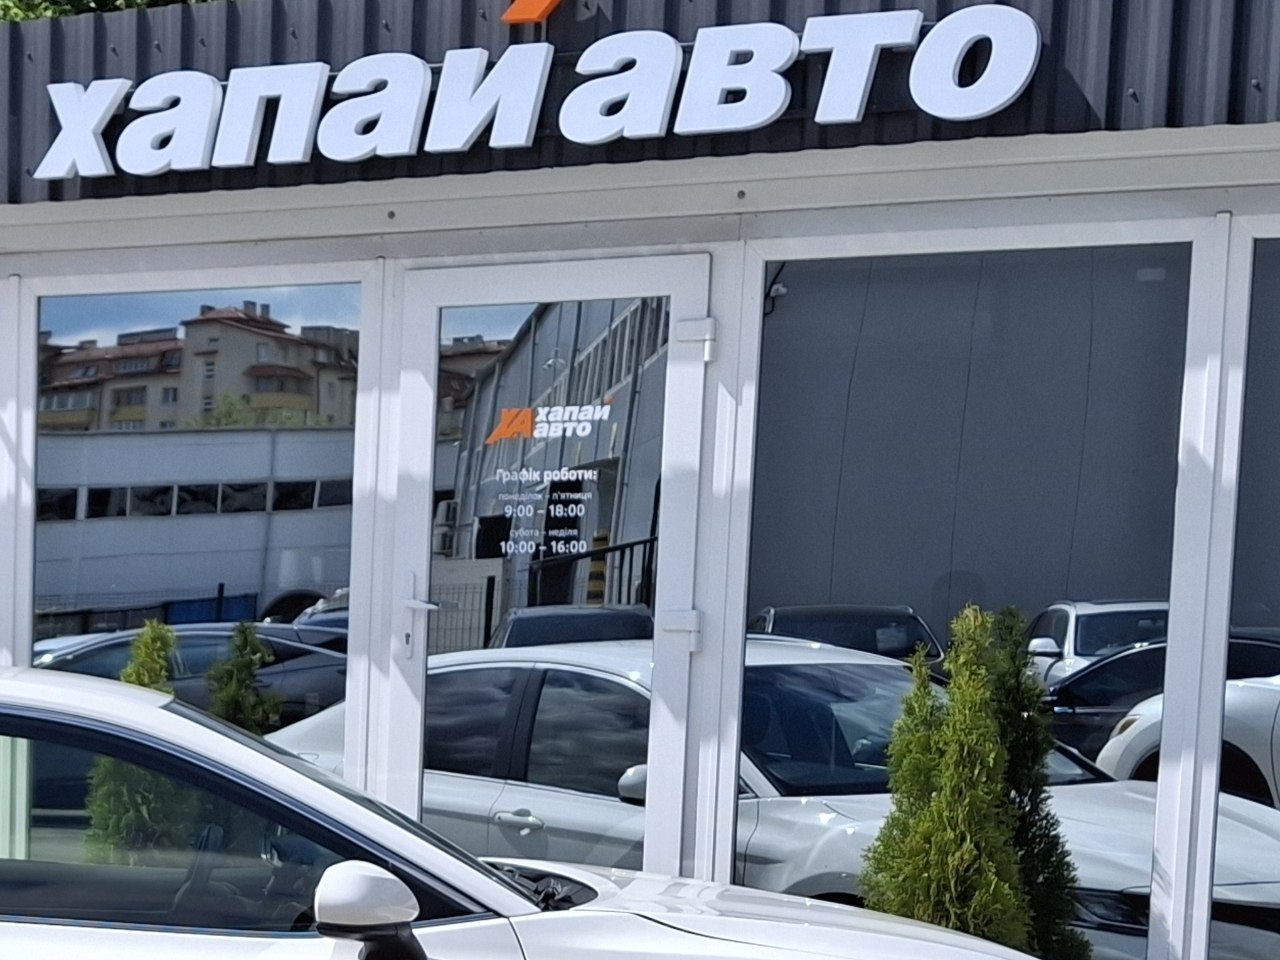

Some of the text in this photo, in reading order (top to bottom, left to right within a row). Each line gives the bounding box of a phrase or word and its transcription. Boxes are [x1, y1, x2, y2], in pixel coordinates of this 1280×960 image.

[33, 0, 1042, 180] хапай авто
[535, 395, 613, 422] хапай
[533, 421, 592, 438] авто
[496, 467, 598, 484] Графік роботи:
[504, 504, 534, 518] 9:00
[548, 503, 586, 517] 18:00
[509, 527, 539, 538] субота
[548, 526, 578, 538] неділя
[499, 540, 536, 554] 10:00
[550, 540, 588, 554] 16:00
